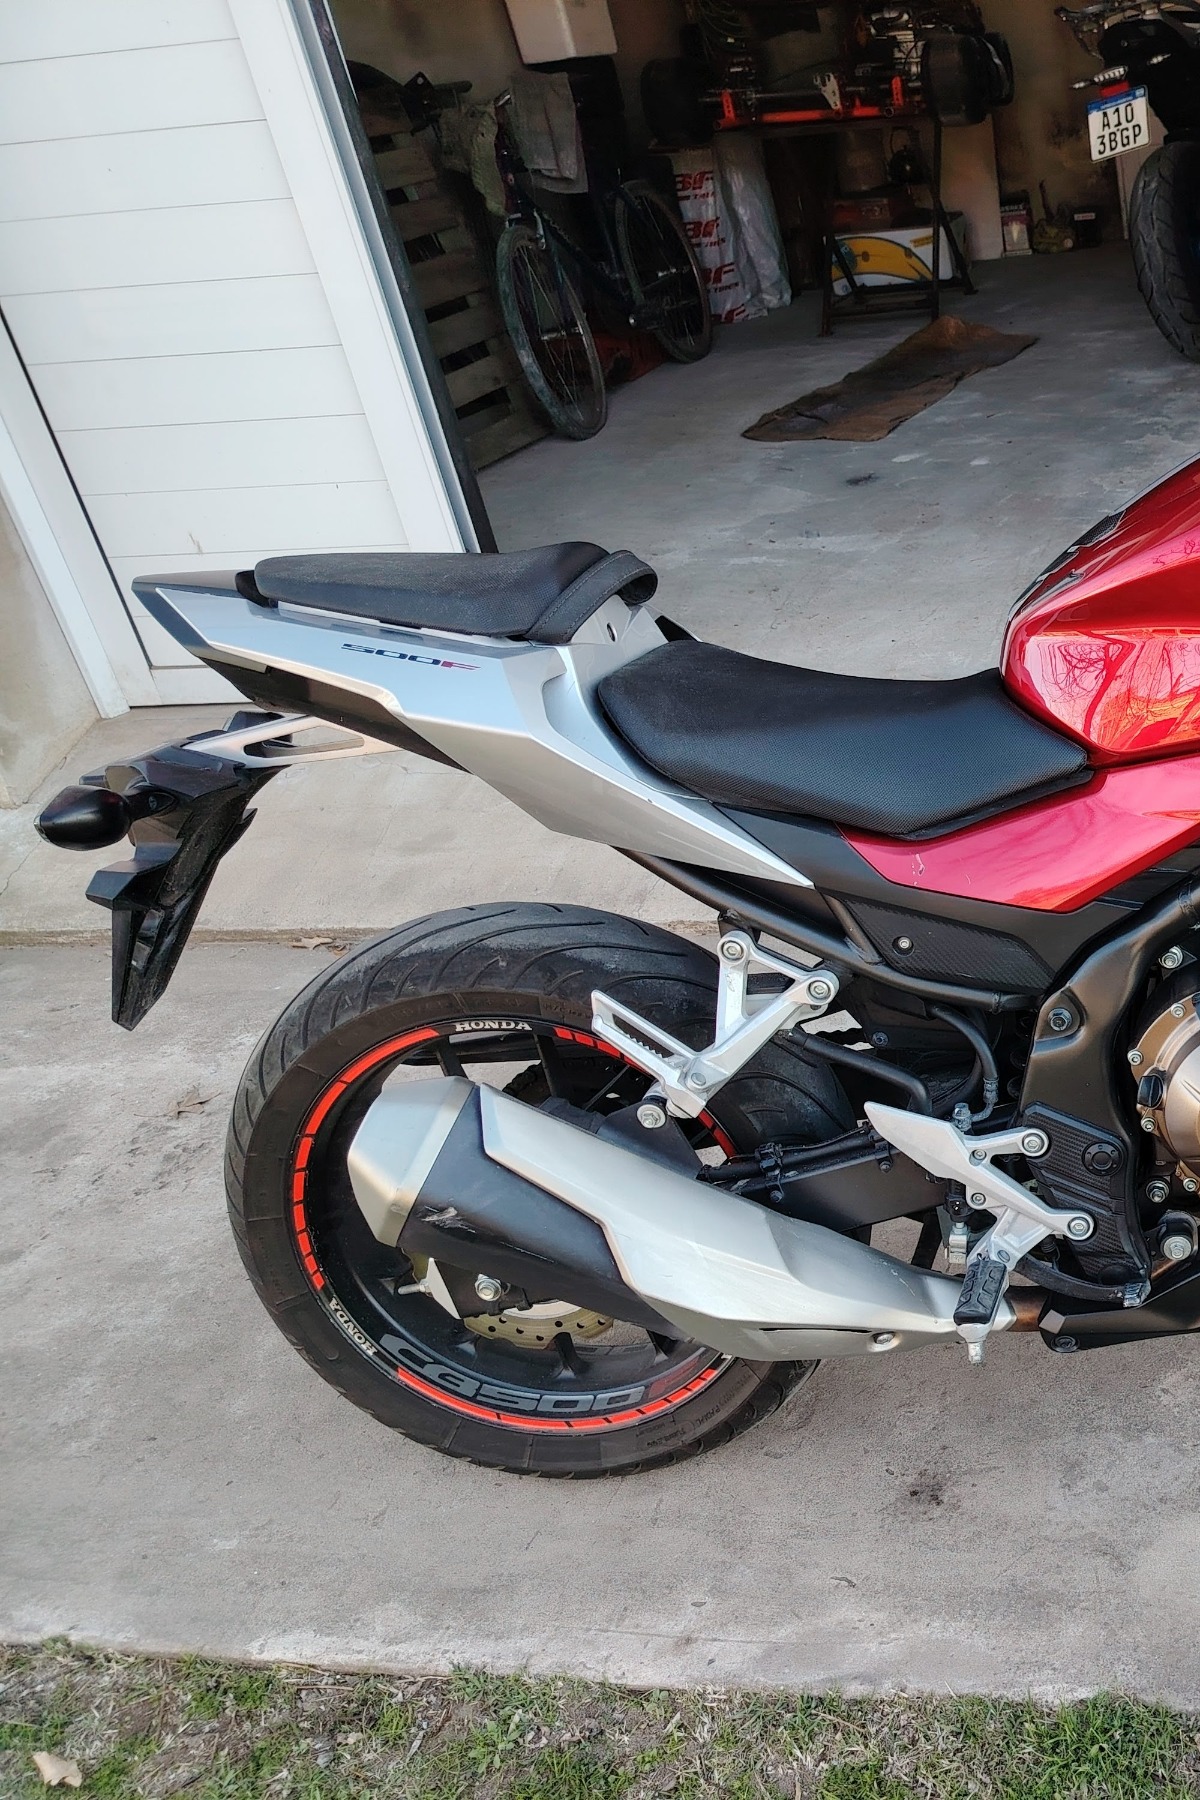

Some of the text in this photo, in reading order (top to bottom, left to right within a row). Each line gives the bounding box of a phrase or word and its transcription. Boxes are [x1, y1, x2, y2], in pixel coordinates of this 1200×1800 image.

[1102, 102, 1134, 132] A10
[1096, 124, 1141, 155] 3BGP
[341, 643, 481, 671] 500F
[455, 1021, 532, 1032] HONDA
[330, 1297, 379, 1357] HONDA
[378, 1333, 701, 1413] CB500F
